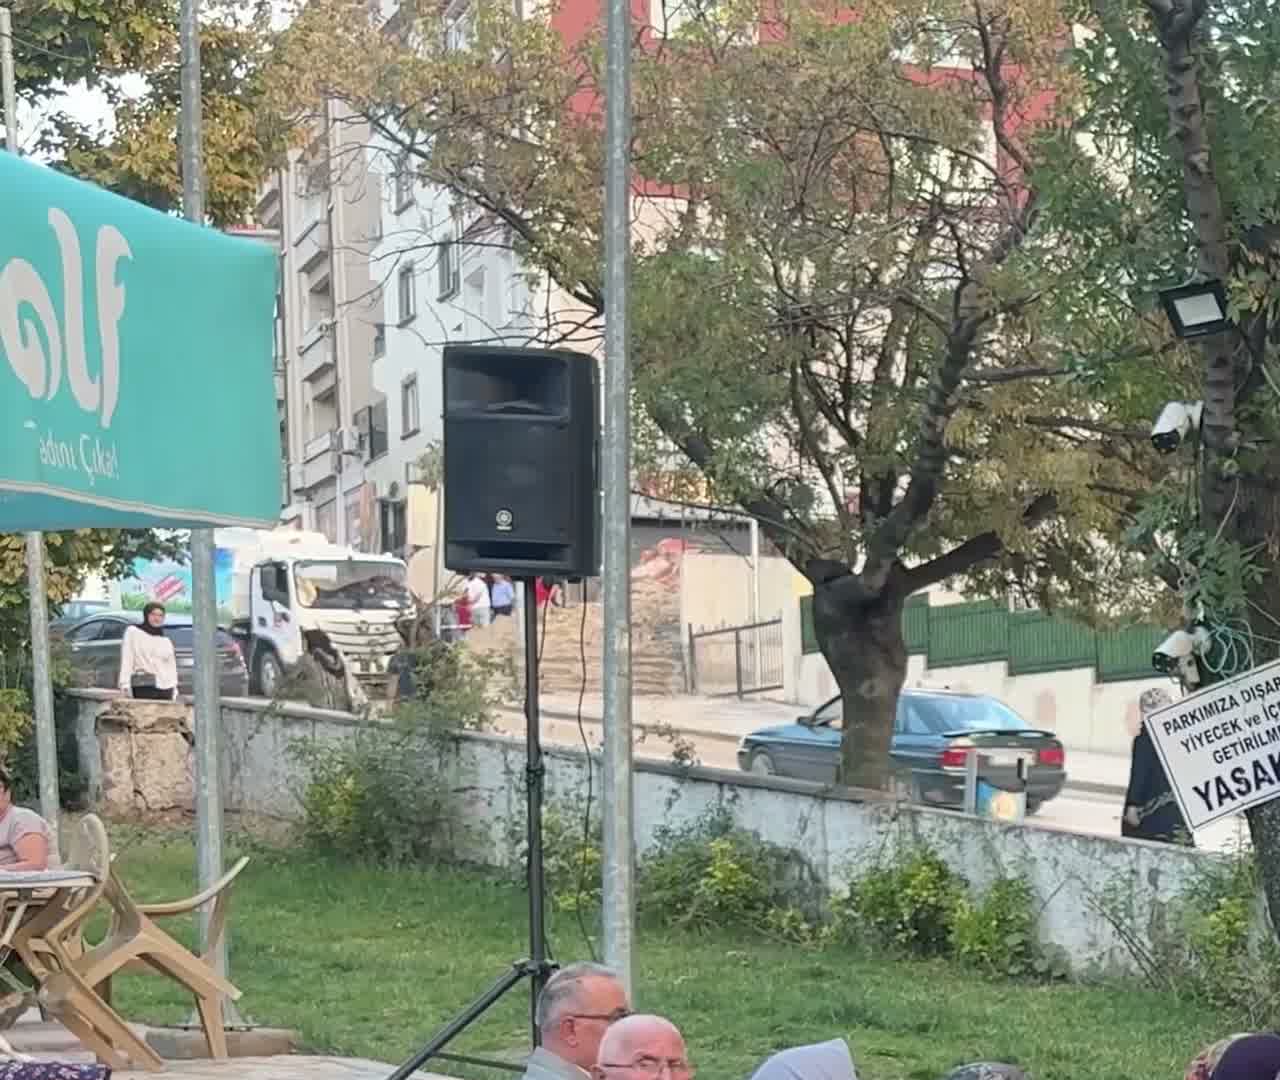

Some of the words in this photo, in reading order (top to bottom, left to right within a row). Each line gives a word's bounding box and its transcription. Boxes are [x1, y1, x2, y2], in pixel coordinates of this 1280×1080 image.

[1162, 694, 1241, 736] PARKIMIZA
[1180, 717, 1243, 754] YİYECEK
[1245, 713, 1262, 728] ve
